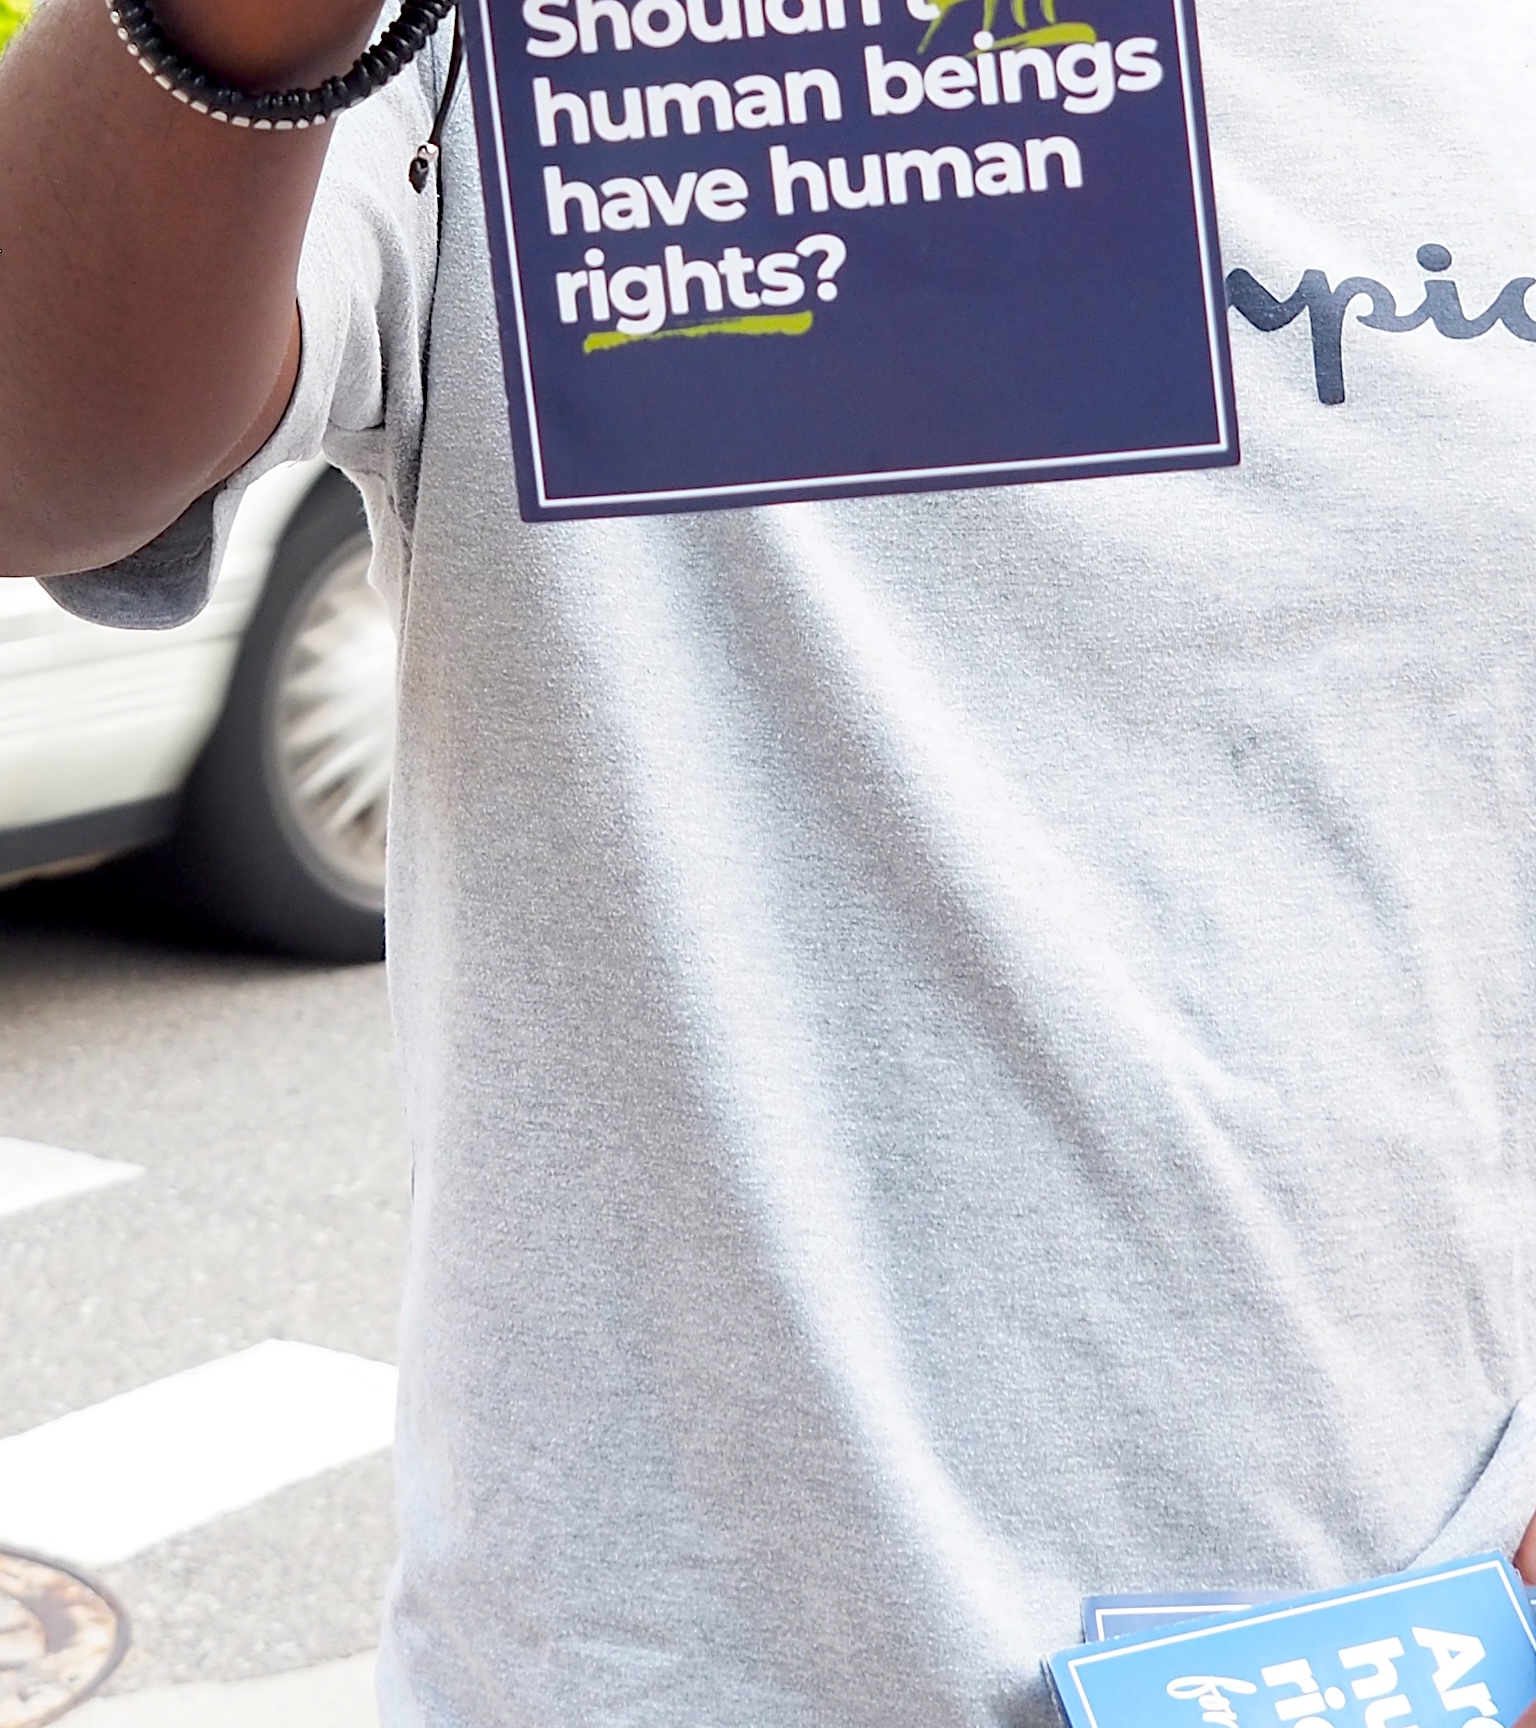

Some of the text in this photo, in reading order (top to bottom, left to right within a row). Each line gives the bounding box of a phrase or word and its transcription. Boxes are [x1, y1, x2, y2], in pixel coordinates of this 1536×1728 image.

[533, 29, 1164, 147] human beings
[543, 136, 1084, 235] have human
[555, 234, 848, 336] rights?
[1261, 1658, 1347, 1728] ri
[1412, 1626, 1506, 1728] Ar
